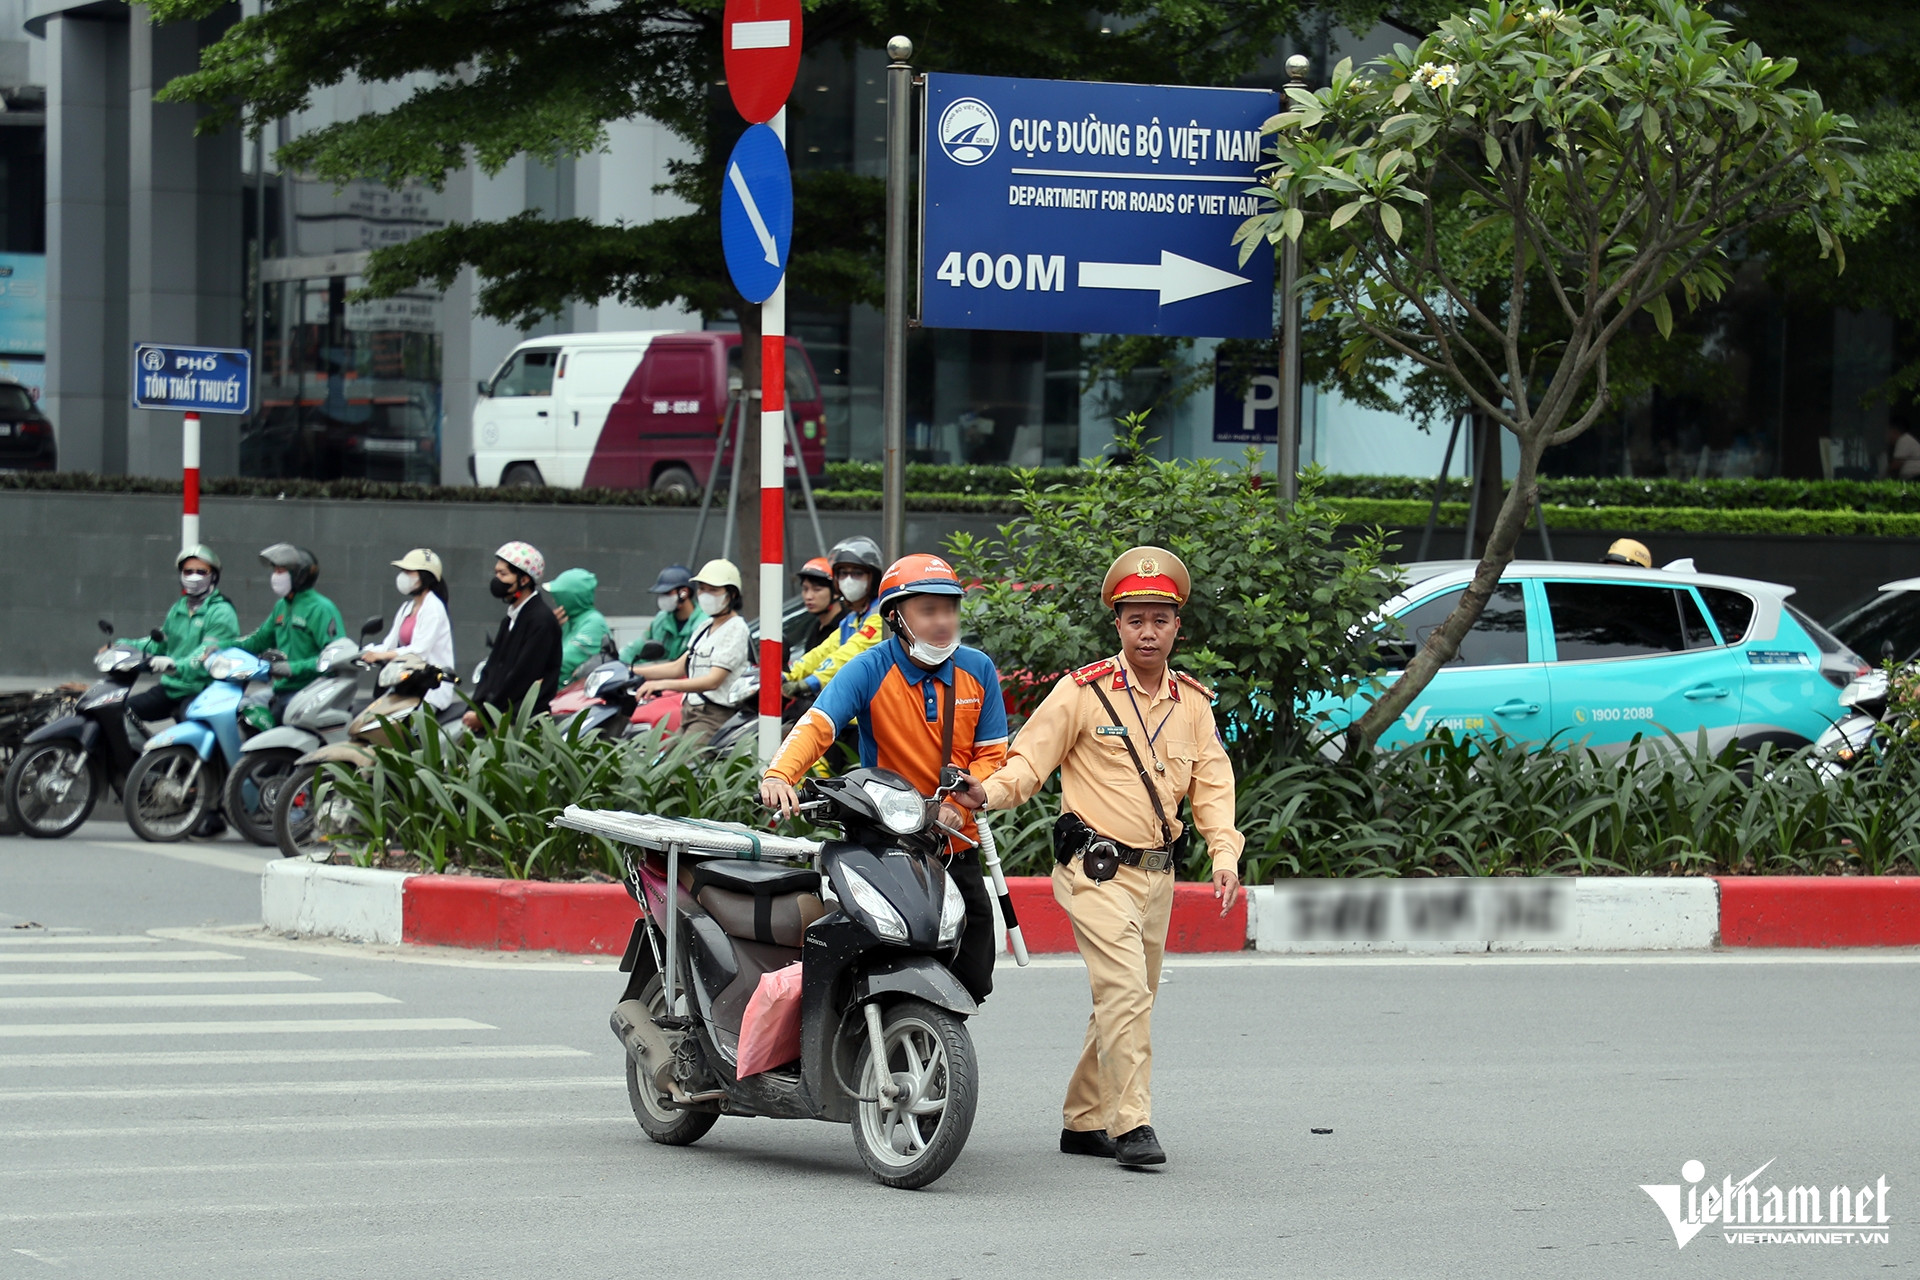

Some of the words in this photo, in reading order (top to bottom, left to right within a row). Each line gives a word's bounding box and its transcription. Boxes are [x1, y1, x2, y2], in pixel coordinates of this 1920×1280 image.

[1009, 118, 1052, 158] CỤC
[1056, 113, 1130, 157] ĐƯỜNG
[1135, 116, 1163, 164] BỘ
[1168, 119, 1211, 166] VIỆT
[1215, 129, 1261, 163] NAM
[1009, 185, 1098, 210] DEPARTMENT
[1101, 190, 1127, 211] FOR
[1129, 192, 1175, 214] ROADS
[1178, 194, 1195, 214] OF
[1198, 195, 1226, 216] VIET
[1228, 197, 1259, 216] NAM
[936, 251, 1066, 292] 400M
[176, 354, 218, 371] PHỐ
[144, 372, 168, 399] TÔN
[169, 371, 198, 401] THẤT
[199, 373, 241, 404] THUYẾT
[1243, 375, 1280, 431] P
[1465, 718, 1484, 729] SM
[1592, 709, 1621, 721] 1900
[1623, 708, 1653, 720] 2088
[806, 936, 828, 948] HONDA
